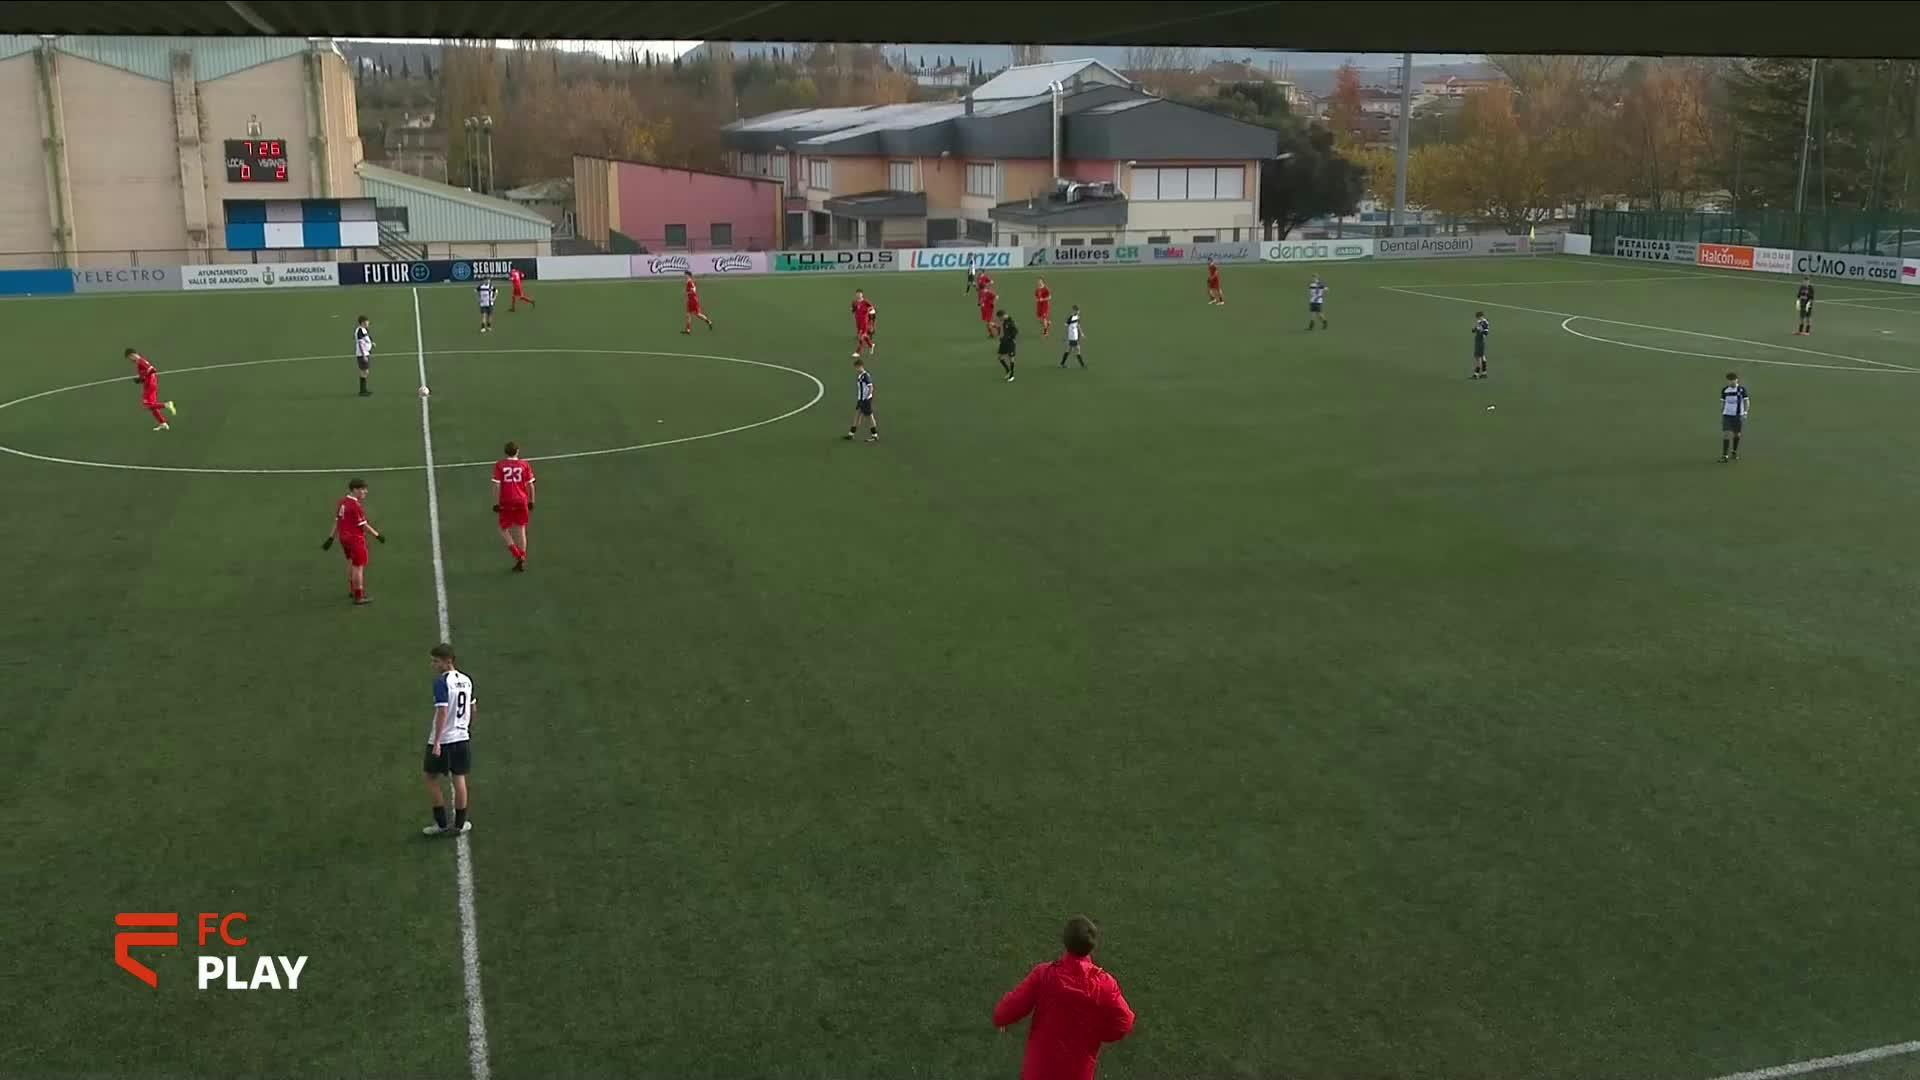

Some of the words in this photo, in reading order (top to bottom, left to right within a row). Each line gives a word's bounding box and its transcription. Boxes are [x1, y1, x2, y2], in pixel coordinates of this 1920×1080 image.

[259, 141, 280, 155] 26
[241, 164, 250, 178] 0
[276, 165, 285, 178] 2
[1380, 240, 1420, 252] Dental
[1617, 239, 1671, 251] METALICAS
[782, 251, 893, 265] TOLDOS
[1055, 247, 1110, 260] talleres
[1116, 247, 1138, 259] CR
[1616, 248, 1669, 260] MUTILVA
[198, 268, 248, 276] AYUNTAMIENTO
[1849, 265, 1865, 276] en
[1868, 267, 1897, 279] casa
[188, 277, 207, 285] VALLE
[219, 276, 259, 284] ARANGUREN
[502, 467, 523, 482] 23
[456, 691, 466, 718] 9
